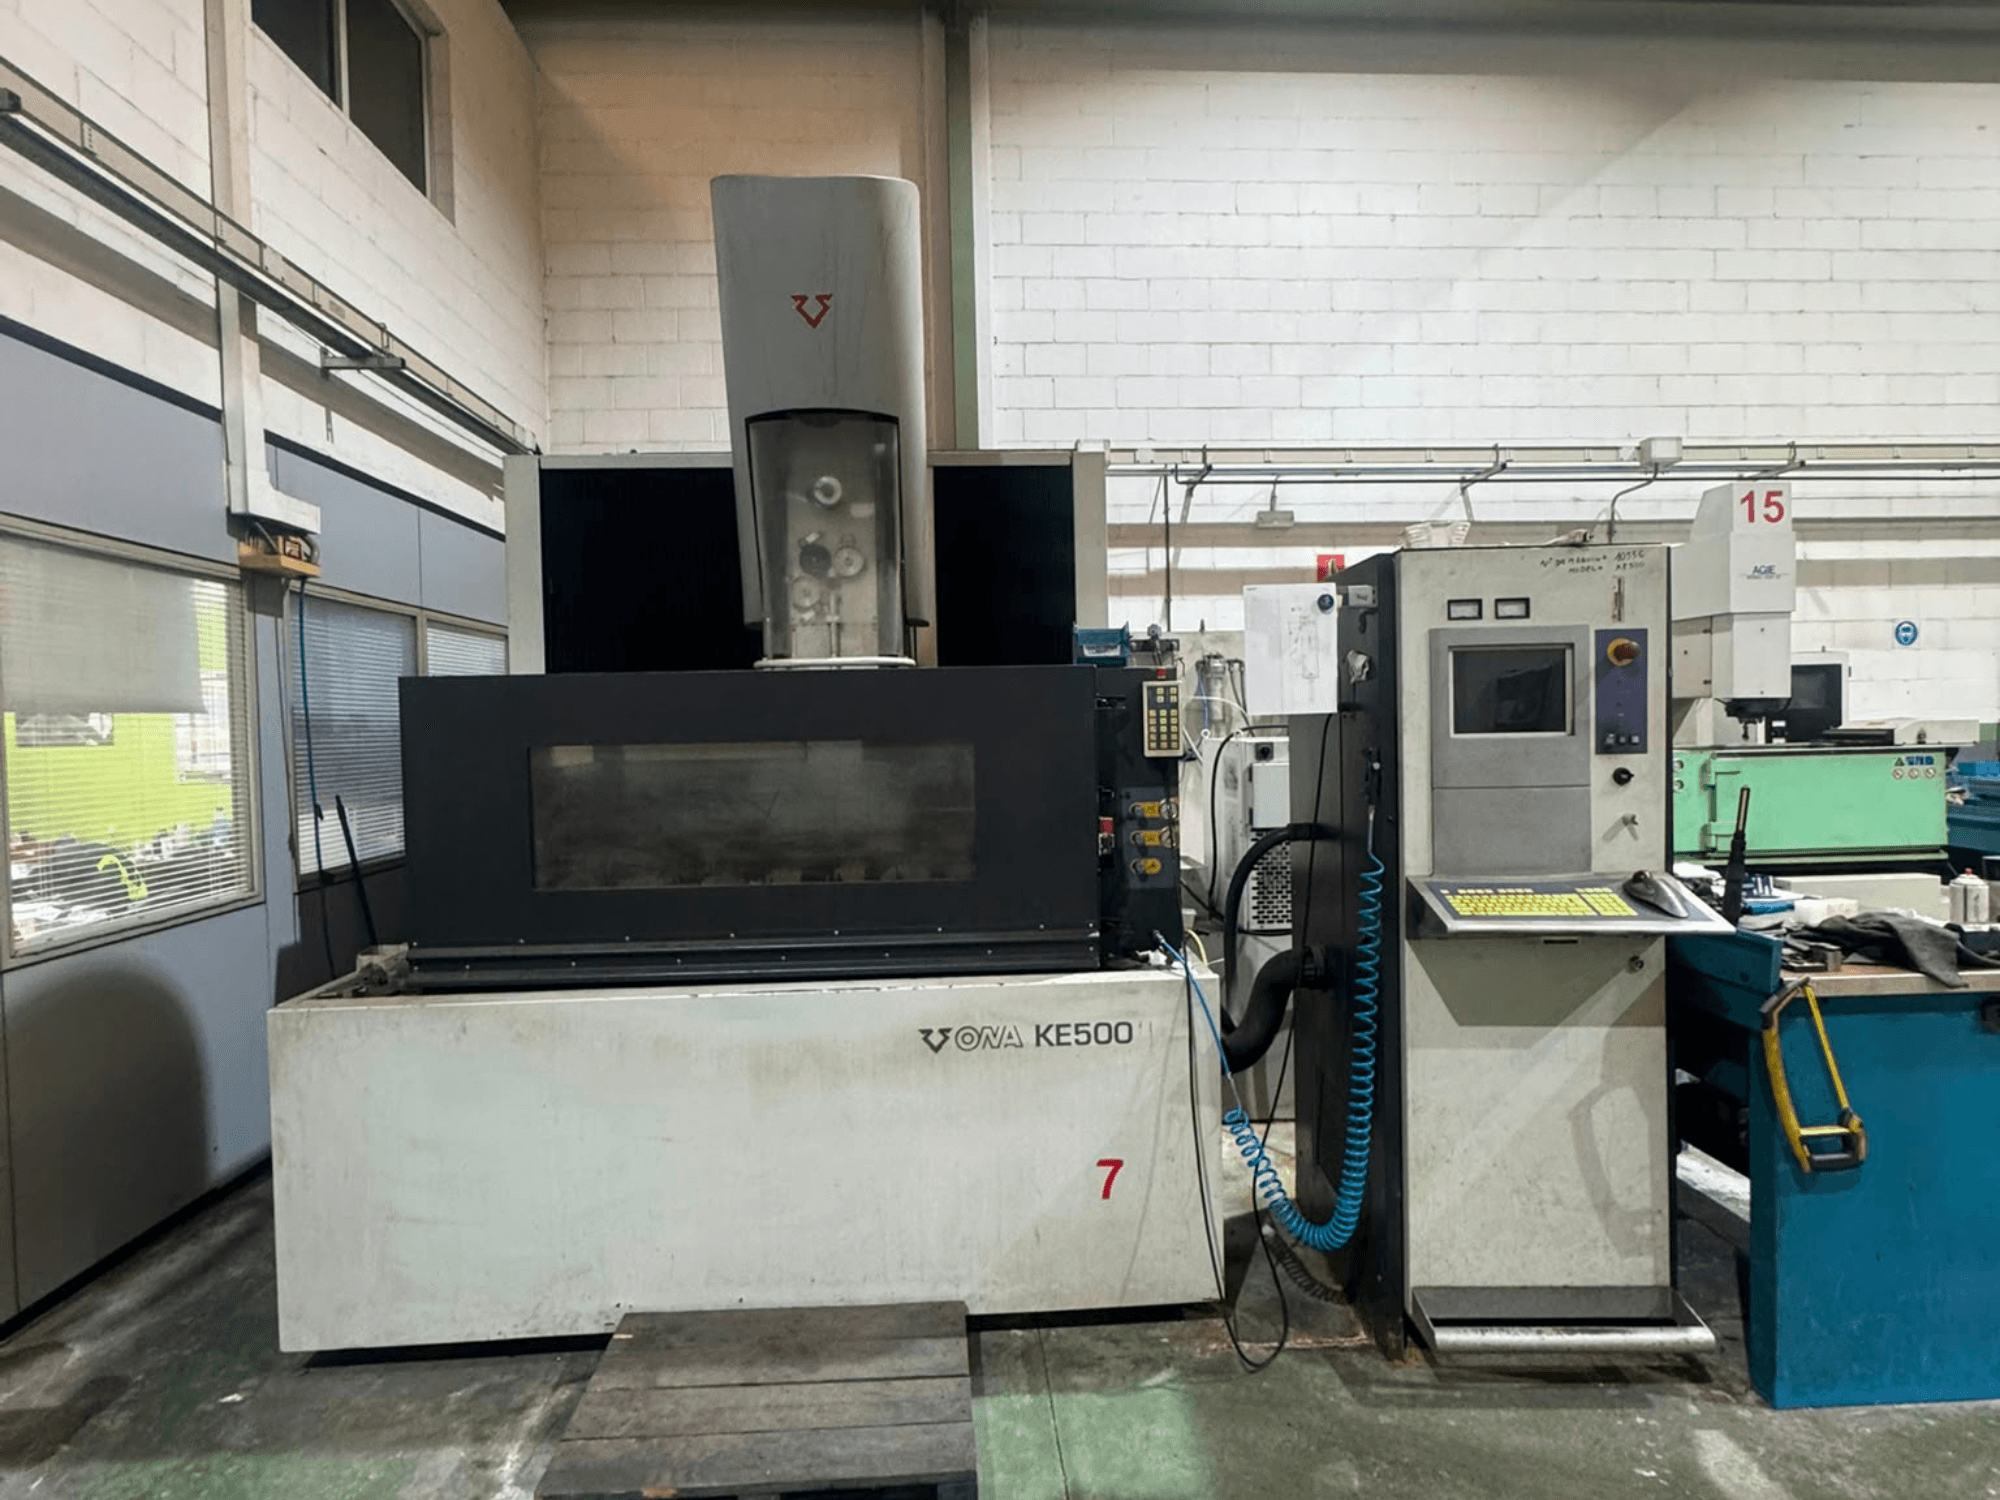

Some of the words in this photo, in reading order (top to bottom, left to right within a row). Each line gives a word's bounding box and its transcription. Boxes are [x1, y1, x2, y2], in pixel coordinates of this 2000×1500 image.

[1741, 490, 1784, 523] 15
[955, 1025, 1023, 1051] ONA
[1035, 1022, 1133, 1047] KE500
[1096, 1159, 1124, 1200] 7
